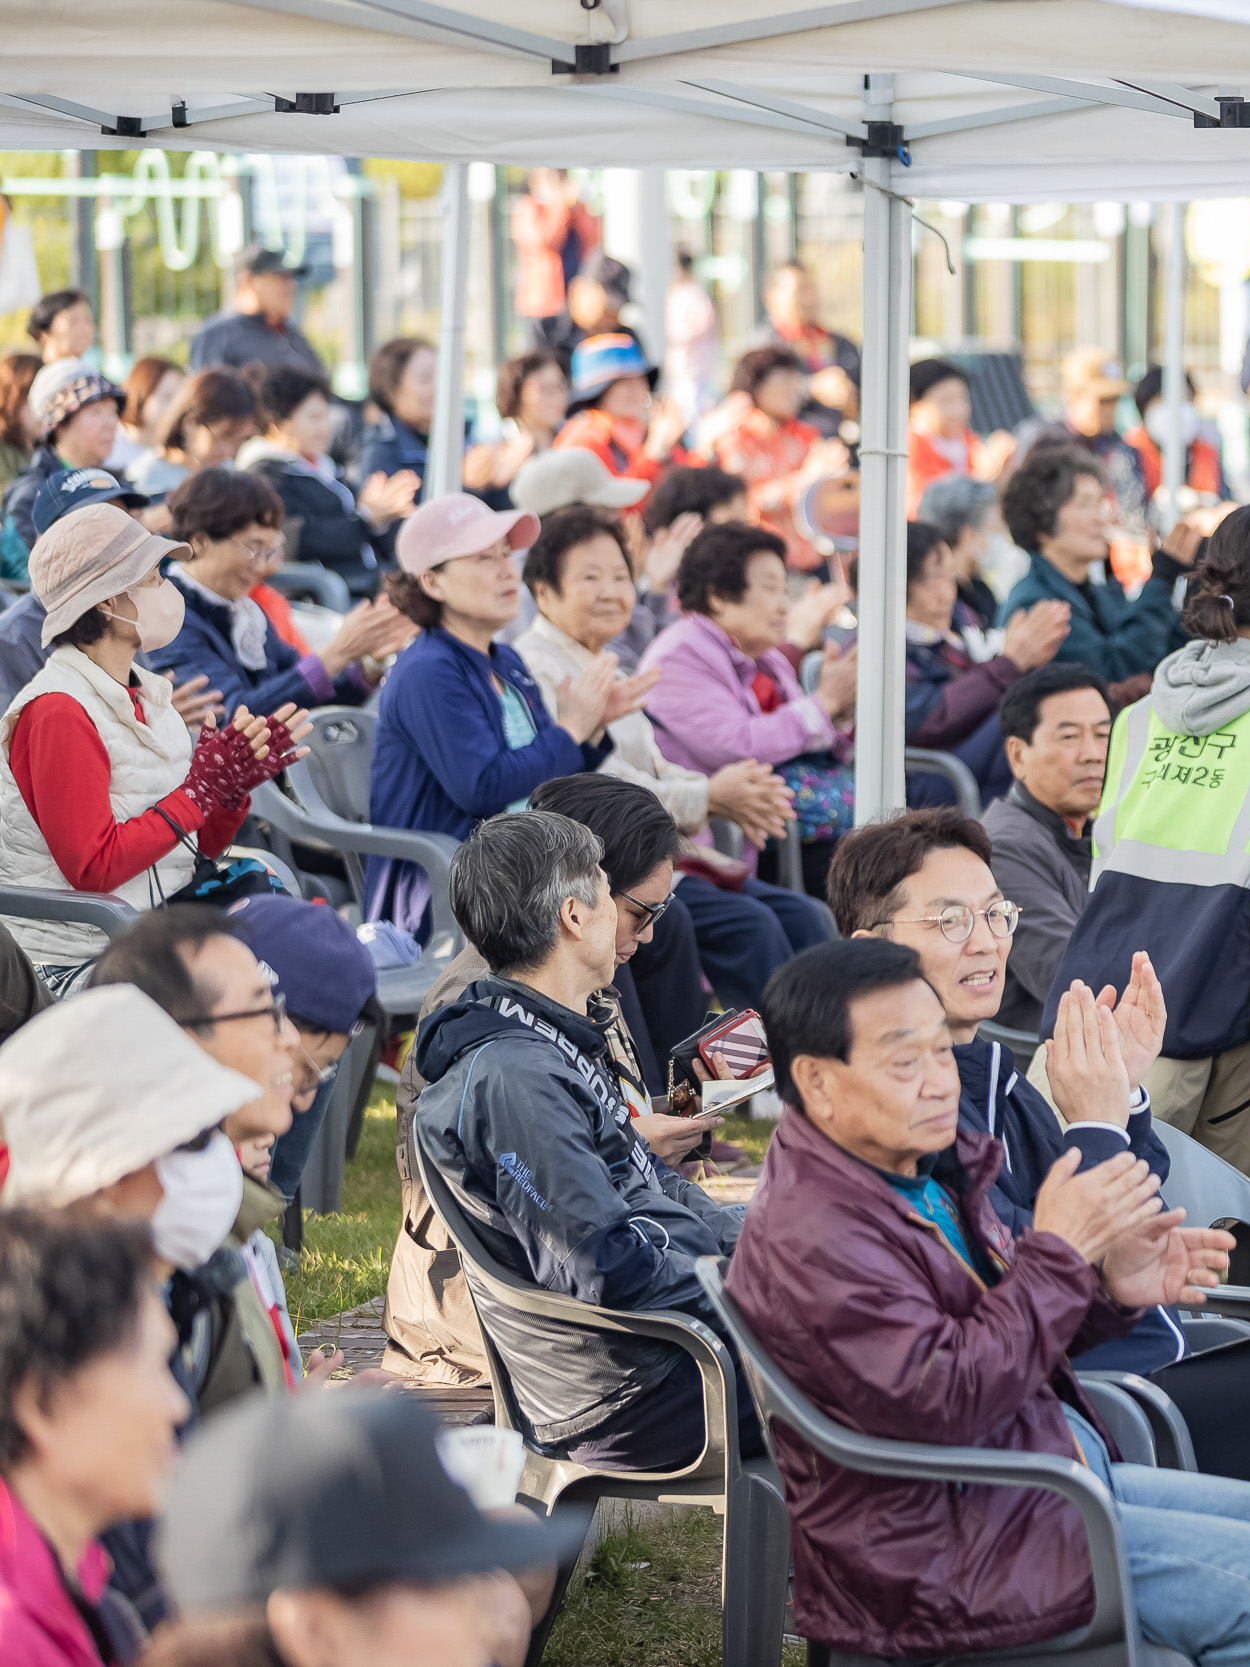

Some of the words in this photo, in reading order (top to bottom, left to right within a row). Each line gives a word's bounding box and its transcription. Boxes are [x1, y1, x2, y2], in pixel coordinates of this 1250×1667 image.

[1149, 732, 1237, 762] 광진구
[516, 1159, 533, 1180] THE
[512, 1170, 549, 1211] REDFACE
